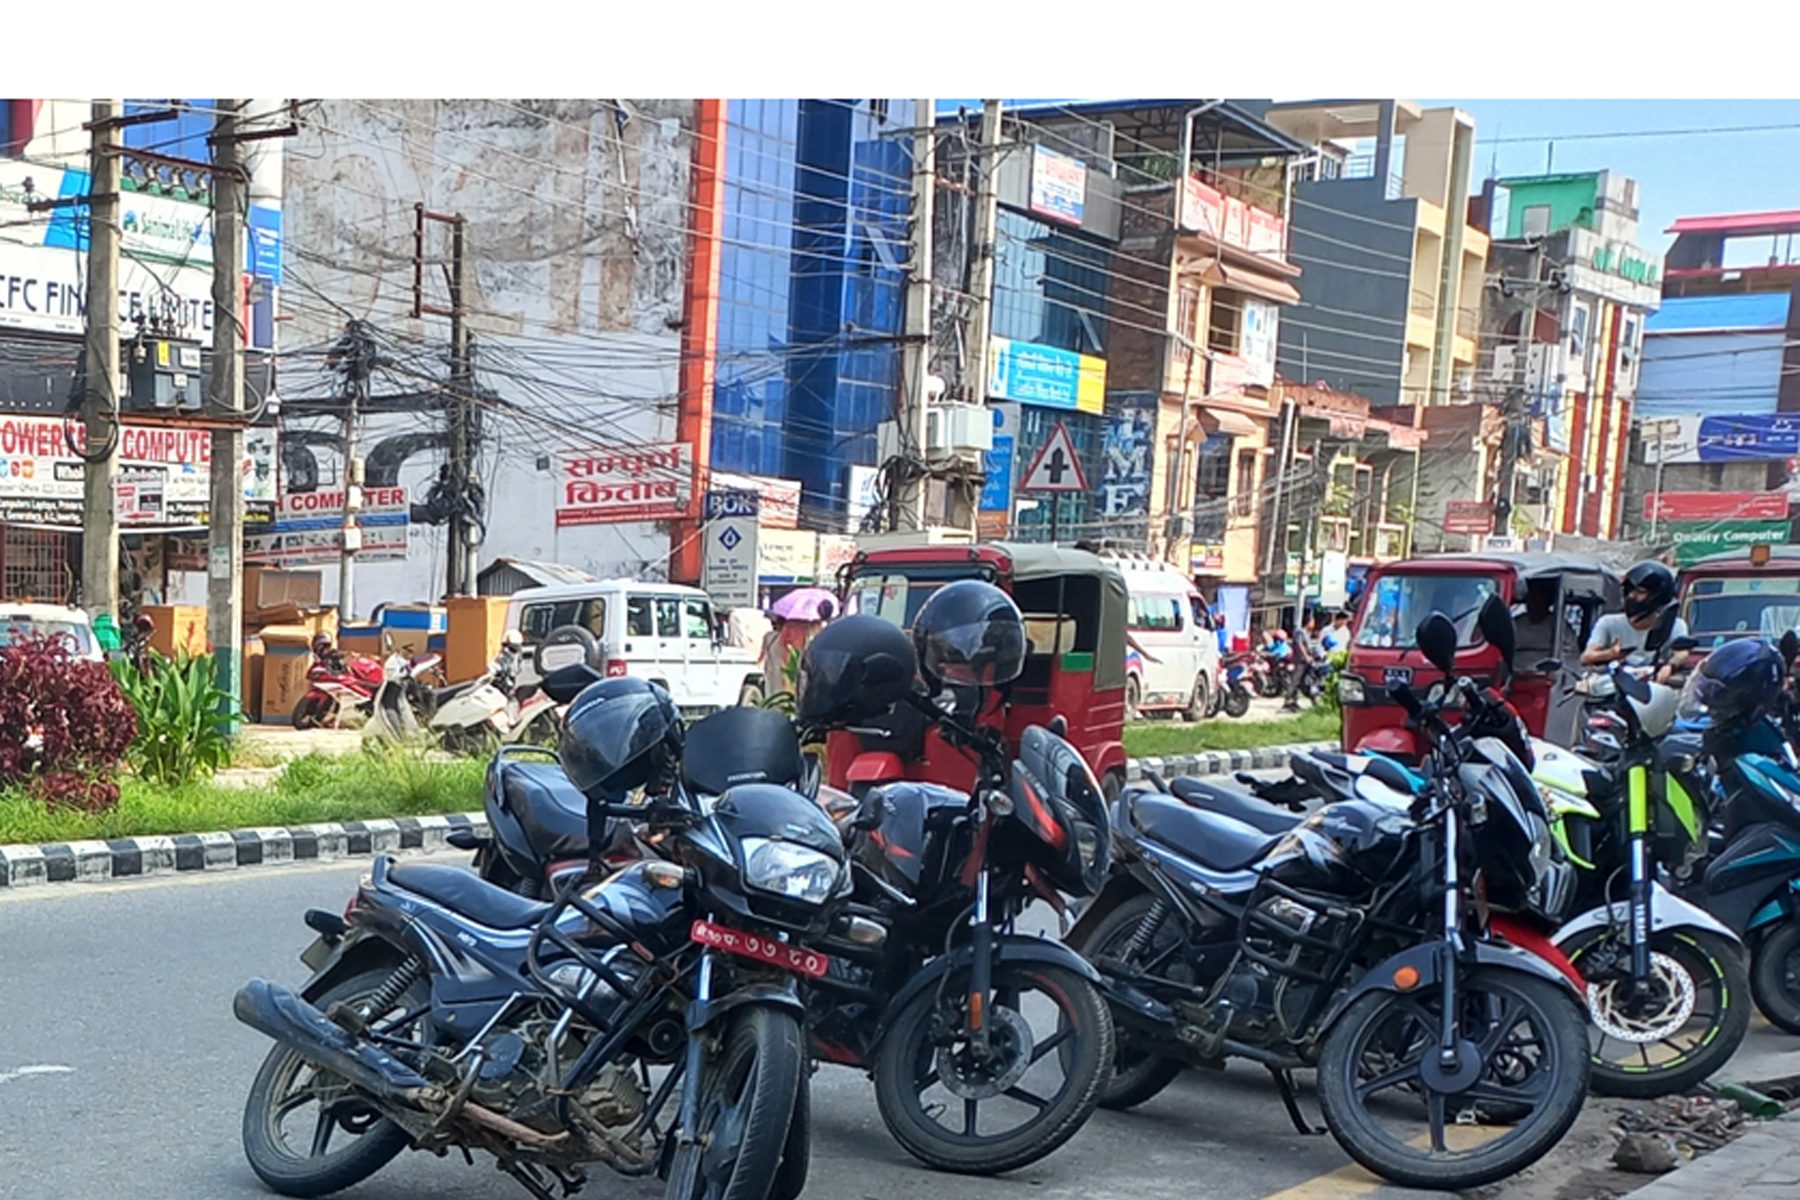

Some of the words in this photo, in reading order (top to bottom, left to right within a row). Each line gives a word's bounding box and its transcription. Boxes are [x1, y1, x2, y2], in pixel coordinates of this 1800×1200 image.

[47, 282, 141, 323] FINCE
[123, 428, 212, 463] COMPUTE
[291, 489, 405, 512] COMPTER
[566, 480, 678, 505] किताब
[1672, 531, 1721, 544] Quality
[1722, 529, 1786, 544] Computer
